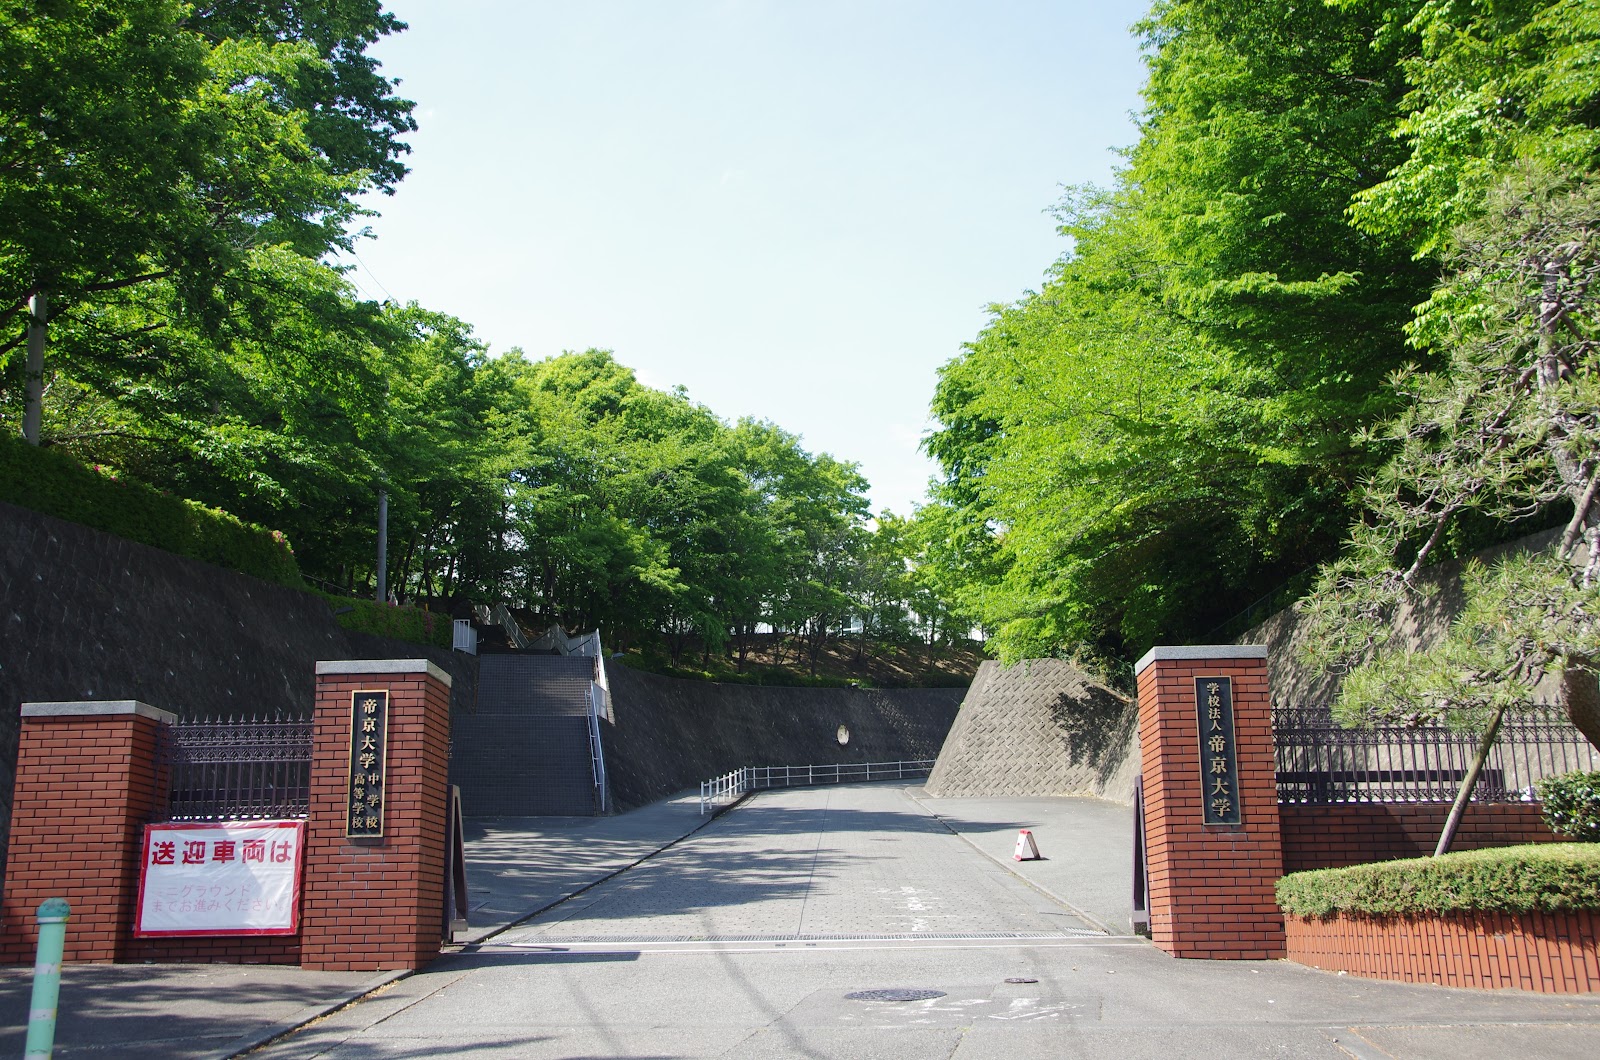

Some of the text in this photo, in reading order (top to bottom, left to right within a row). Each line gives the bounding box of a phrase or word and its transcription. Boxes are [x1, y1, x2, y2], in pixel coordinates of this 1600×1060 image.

[359, 698, 378, 769] 帝京大学
[1206, 682, 1231, 817] 学校法人帝京大学
[352, 772, 365, 829] 高等学校
[366, 772, 380, 829] 中学校
[152, 839, 293, 865] 送迎車両は
